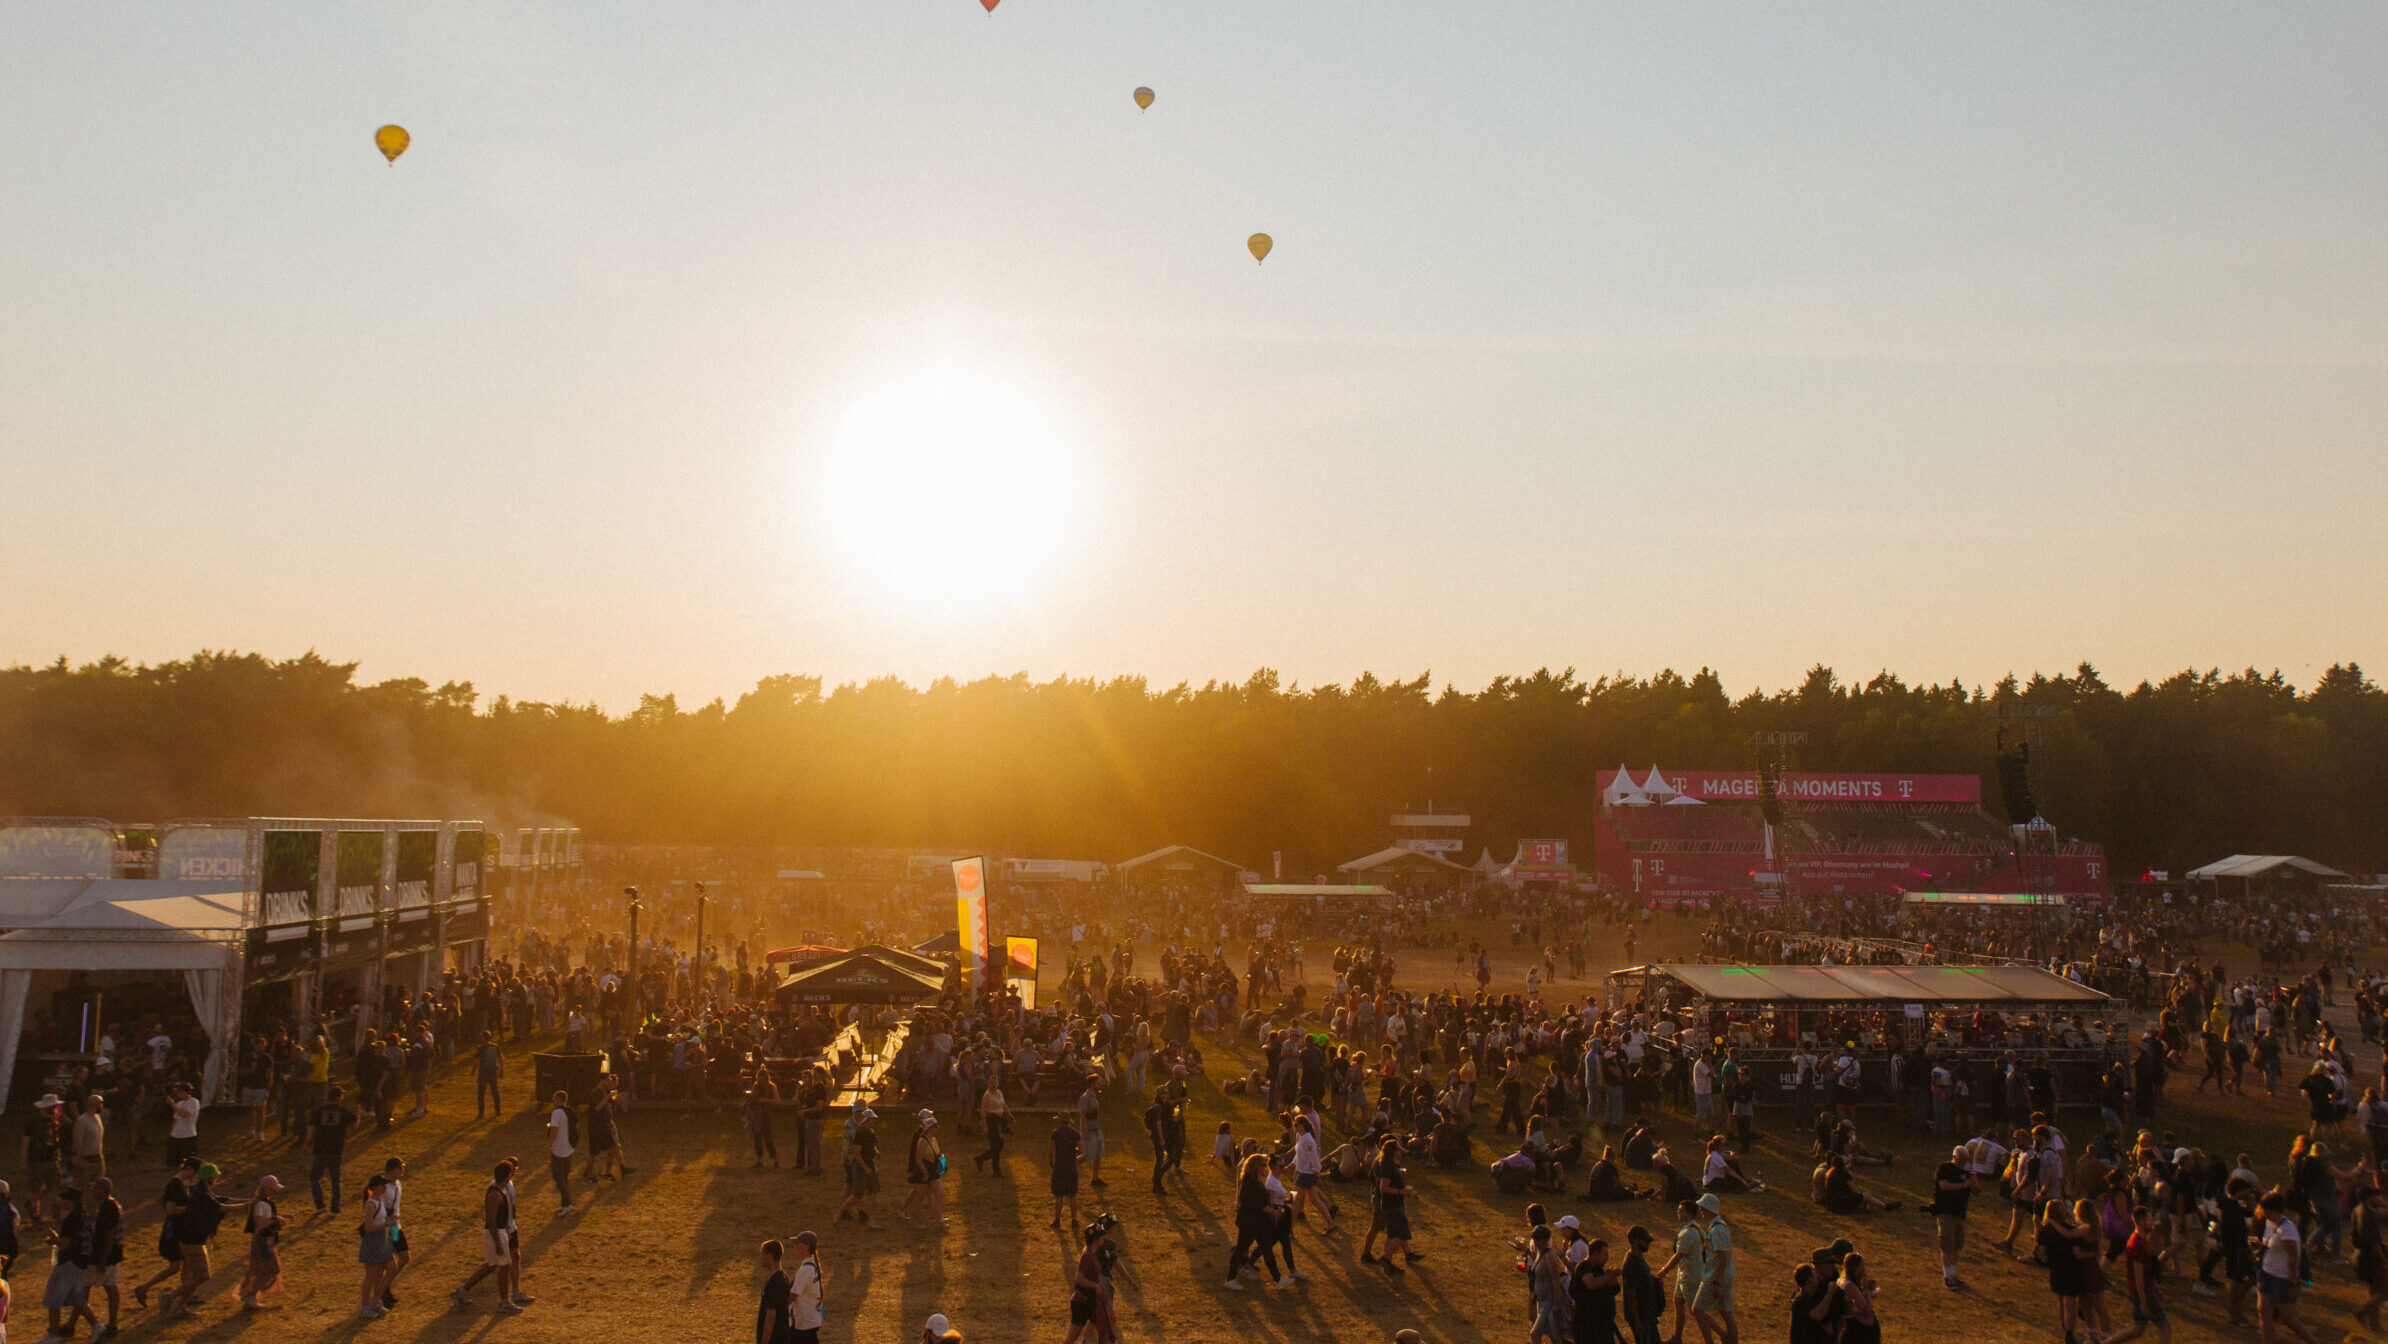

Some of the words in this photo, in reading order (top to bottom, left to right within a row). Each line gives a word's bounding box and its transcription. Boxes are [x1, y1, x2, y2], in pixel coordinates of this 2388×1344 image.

[1793, 780, 1882, 796] MOMENTS
[266, 889, 310, 926] DRINKS
[339, 884, 375, 917] DRINKS
